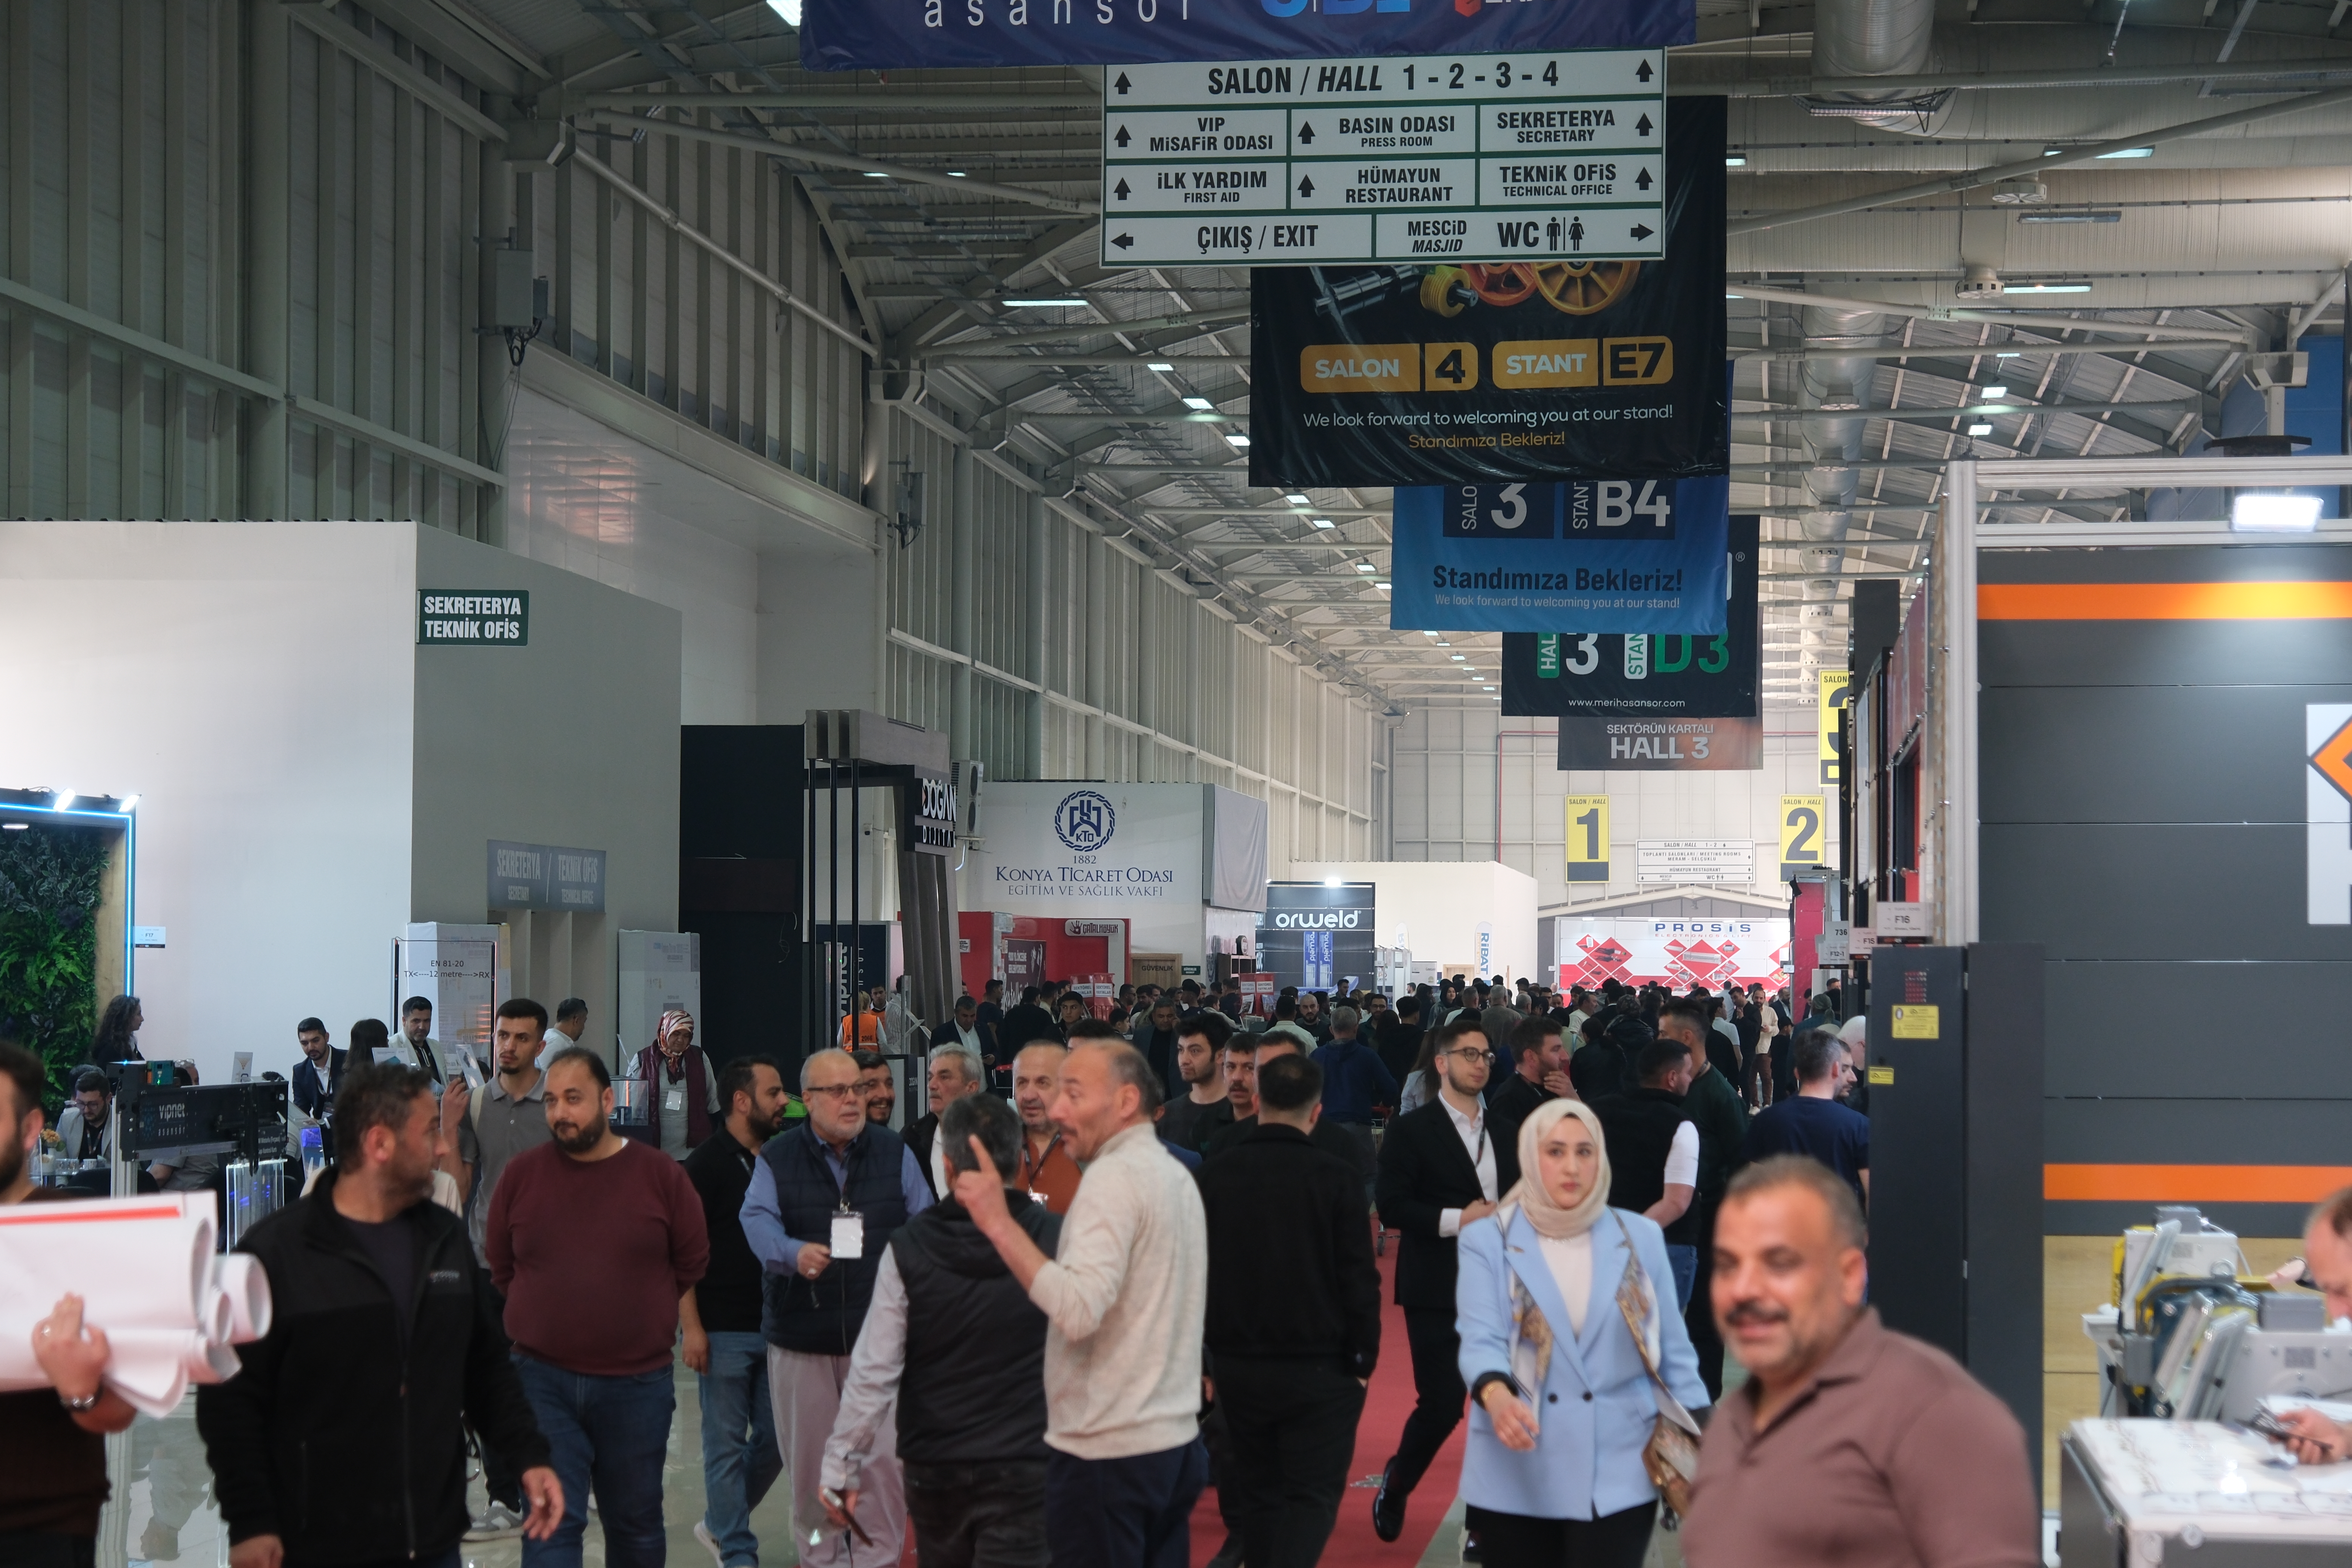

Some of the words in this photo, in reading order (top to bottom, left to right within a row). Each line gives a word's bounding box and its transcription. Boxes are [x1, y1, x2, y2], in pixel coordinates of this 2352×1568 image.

[1208, 67, 1291, 94] SALON
[1300, 66, 1309, 95] /
[1317, 66, 1382, 92] HALL
[1403, 64, 1414, 90] 1
[1449, 63, 1464, 89] 2
[1496, 62, 1511, 87] 3
[1543, 61, 1558, 86] 4
[1197, 118, 1225, 132] VIP
[1339, 117, 1393, 134] BASIN
[1400, 116, 1455, 133] ODASI
[1497, 110, 1615, 129] SEKRETERYA
[1224, 135, 1272, 150] ODASI
[1361, 137, 1396, 147] PRESS
[1400, 136, 1432, 146] ROOM
[1517, 130, 1595, 143] SECRETARY
[1192, 171, 1267, 188] YARDIM
[1358, 165, 1440, 184] HÜMAYUN
[1184, 192, 1216, 203] FIRST
[1220, 192, 1240, 202] AID
[1346, 187, 1453, 203] RESTAURANT
[1503, 185, 1567, 196] TECHNICAL
[1571, 184, 1612, 195] OFFICE
[1197, 226, 1252, 254] ÇIKIŞ
[1259, 225, 1267, 250] /
[1274, 225, 1318, 247] EXIT
[1498, 222, 1539, 247] WC
[1412, 239, 1462, 253] MASJID
[1315, 358, 1400, 378] SALON
[1435, 349, 1465, 383] 4
[1507, 354, 1587, 375] STANT
[1610, 343, 1666, 379] E7
[1303, 414, 1329, 427] We
[1333, 413, 1363, 426] look
[1366, 411, 1430, 426] forward
[1433, 413, 1450, 425] to
[1453, 410, 1537, 427] welcoming
[1540, 411, 1568, 424] you
[1573, 409, 1589, 421] at
[1593, 409, 1620, 420] our
[1623, 404, 1673, 420] stand!
[1409, 433, 1496, 448] Standımıza
[1501, 432, 1565, 446] Bekleriz!
[1462, 486, 1477, 530] SALO
[1491, 483, 1527, 529] 3
[1573, 482, 1589, 529] STAN
[1597, 480, 1670, 527] B4
[1433, 565, 1567, 590] Standımıza
[1576, 568, 1682, 591] Bekleriz!
[424, 596, 521, 615] SEKRETERYA
[1435, 594, 1450, 605] We
[1453, 594, 1473, 605] look
[1477, 595, 1517, 606] forward
[1521, 596, 1531, 606] to
[1534, 597, 1589, 609] welcoming
[1592, 599, 1611, 609] you
[1614, 598, 1624, 608] at
[1647, 597, 1679, 608] stand!
[425, 617, 480, 639] TEKNİK
[484, 617, 520, 639] OFİS
[1541, 634, 1556, 669] HAL
[1566, 633, 1599, 675] 3
[1628, 634, 1643, 675] STAN
[1655, 629, 1729, 673] D3
[1568, 698, 1685, 707] www.merihasansor.com
[1607, 723, 1666, 734] SEKTÖRÜN
[1669, 724, 1713, 734] KARTALI
[1611, 737, 1684, 759] HALL
[1692, 737, 1710, 759] 3
[923, 778, 956, 822] DOĞAN
[1076, 830, 1093, 842] KTO
[1577, 808, 1598, 859] 1
[1786, 807, 1818, 861] 2
[497, 848, 541, 880] SEKRETERYA
[1073, 855, 1096, 864] 1882
[1059, 886, 1073, 896] VE
[1079, 884, 1124, 896] SAĞLIK
[1127, 886, 1163, 896] VAKFI
[1276, 910, 1358, 928] orweld
[159, 1103, 185, 1121] vipnet
